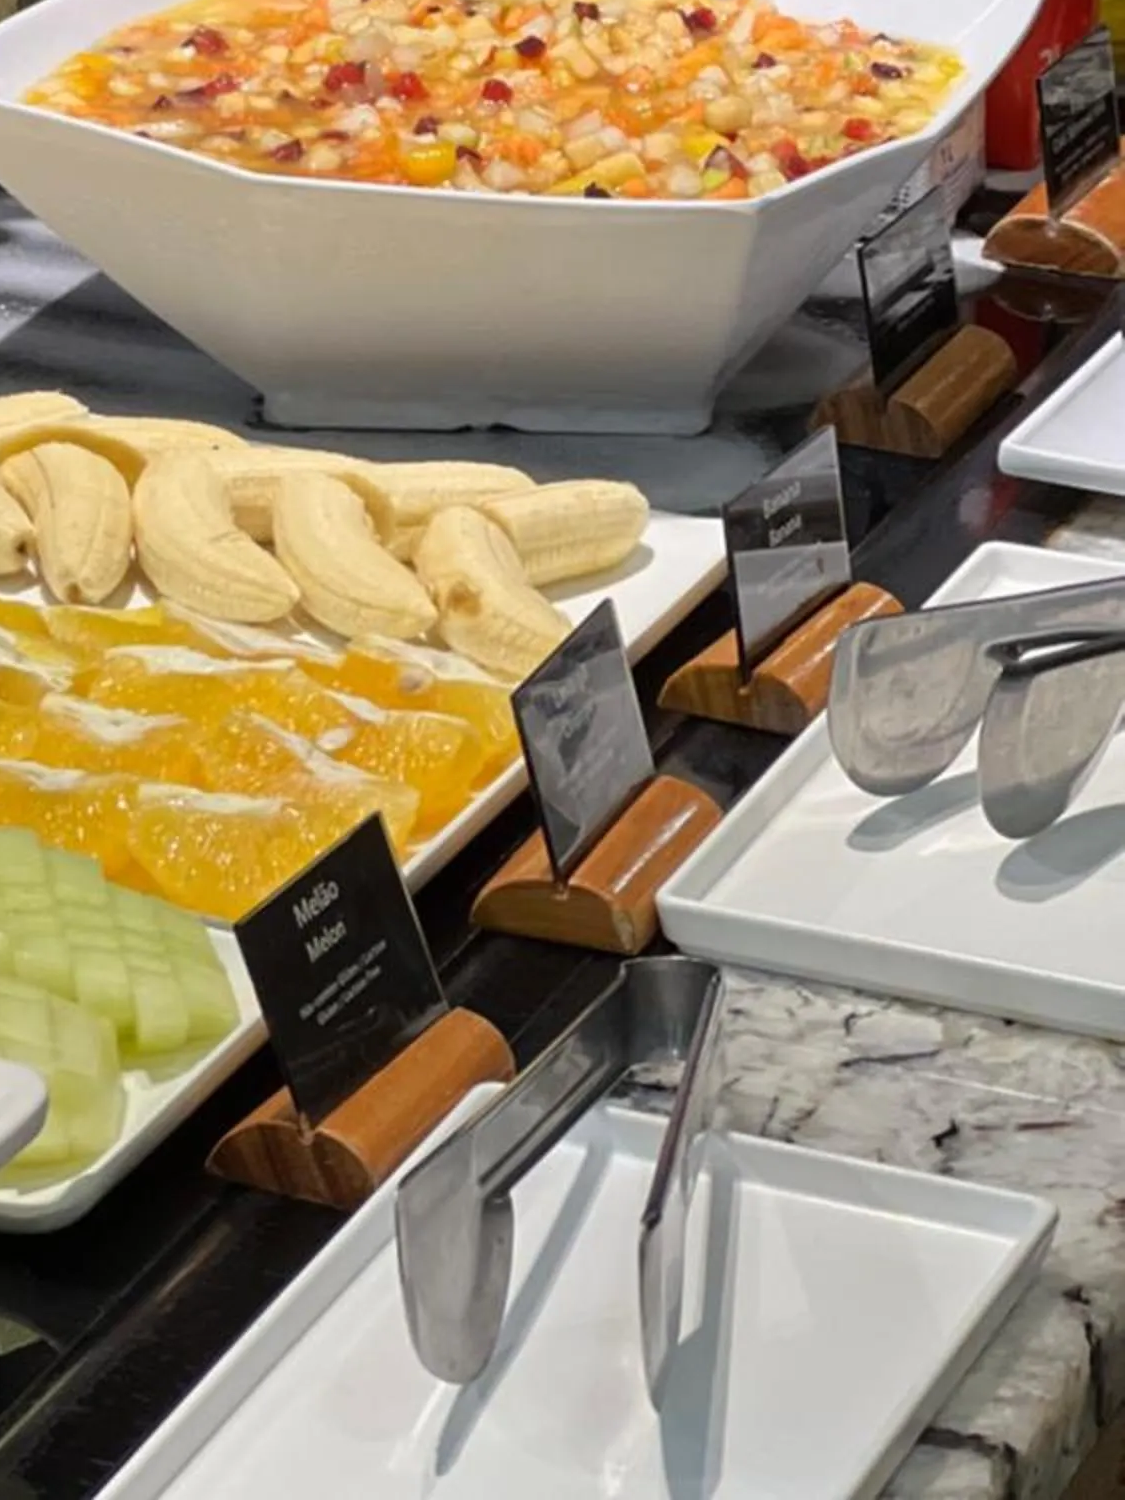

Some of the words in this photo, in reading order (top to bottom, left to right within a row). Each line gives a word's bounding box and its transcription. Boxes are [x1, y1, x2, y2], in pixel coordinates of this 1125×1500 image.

[763, 481, 802, 520] Banana
[768, 513, 803, 548] Banana
[292, 880, 340, 930] Melão
[305, 920, 348, 964] Melon
